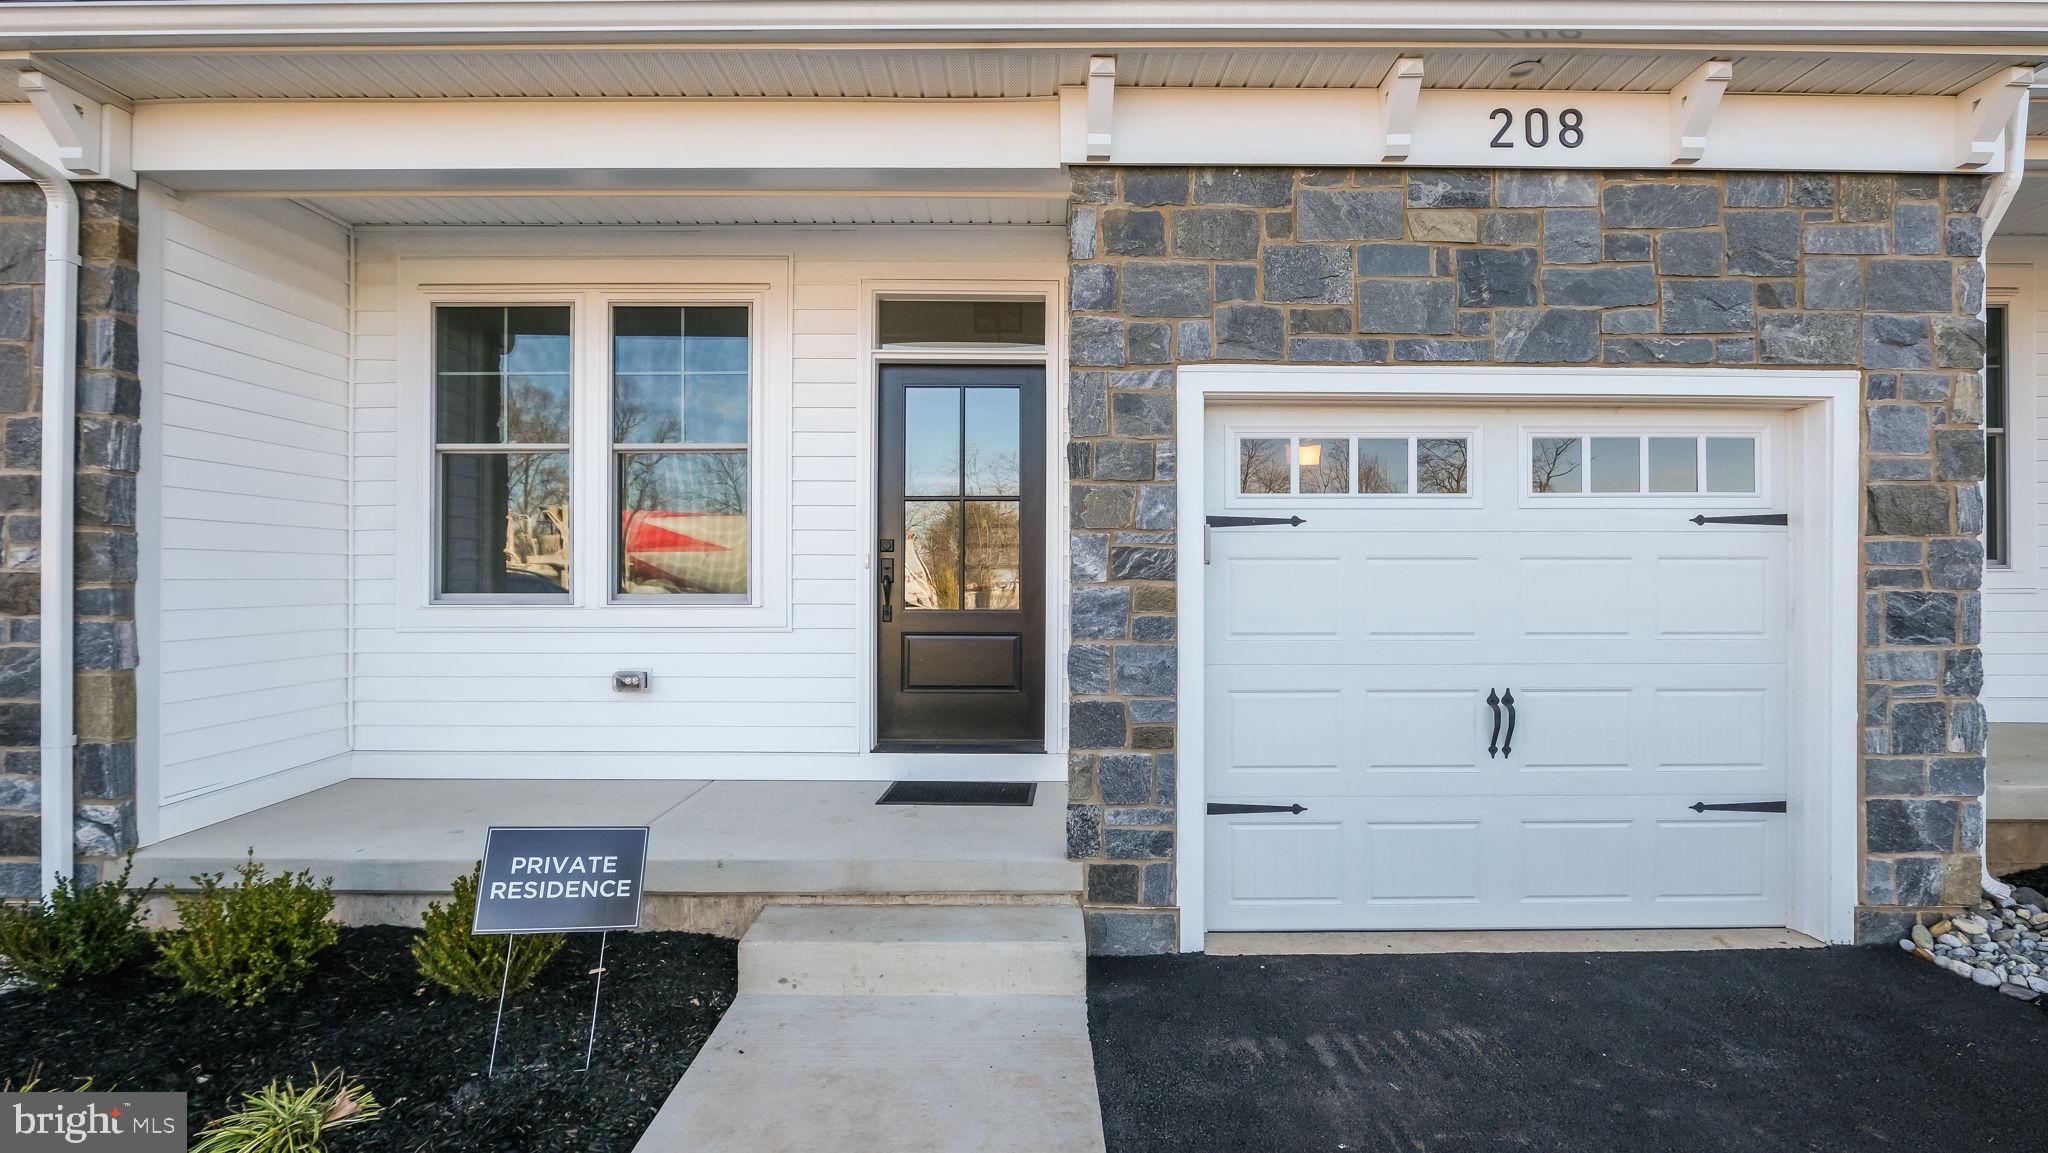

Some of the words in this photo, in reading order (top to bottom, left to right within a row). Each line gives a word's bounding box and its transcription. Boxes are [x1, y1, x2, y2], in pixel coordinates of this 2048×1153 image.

[1489, 107, 1584, 148] 208
[511, 856, 618, 875] PRIVATE
[489, 879, 632, 900] RESIDENCE
